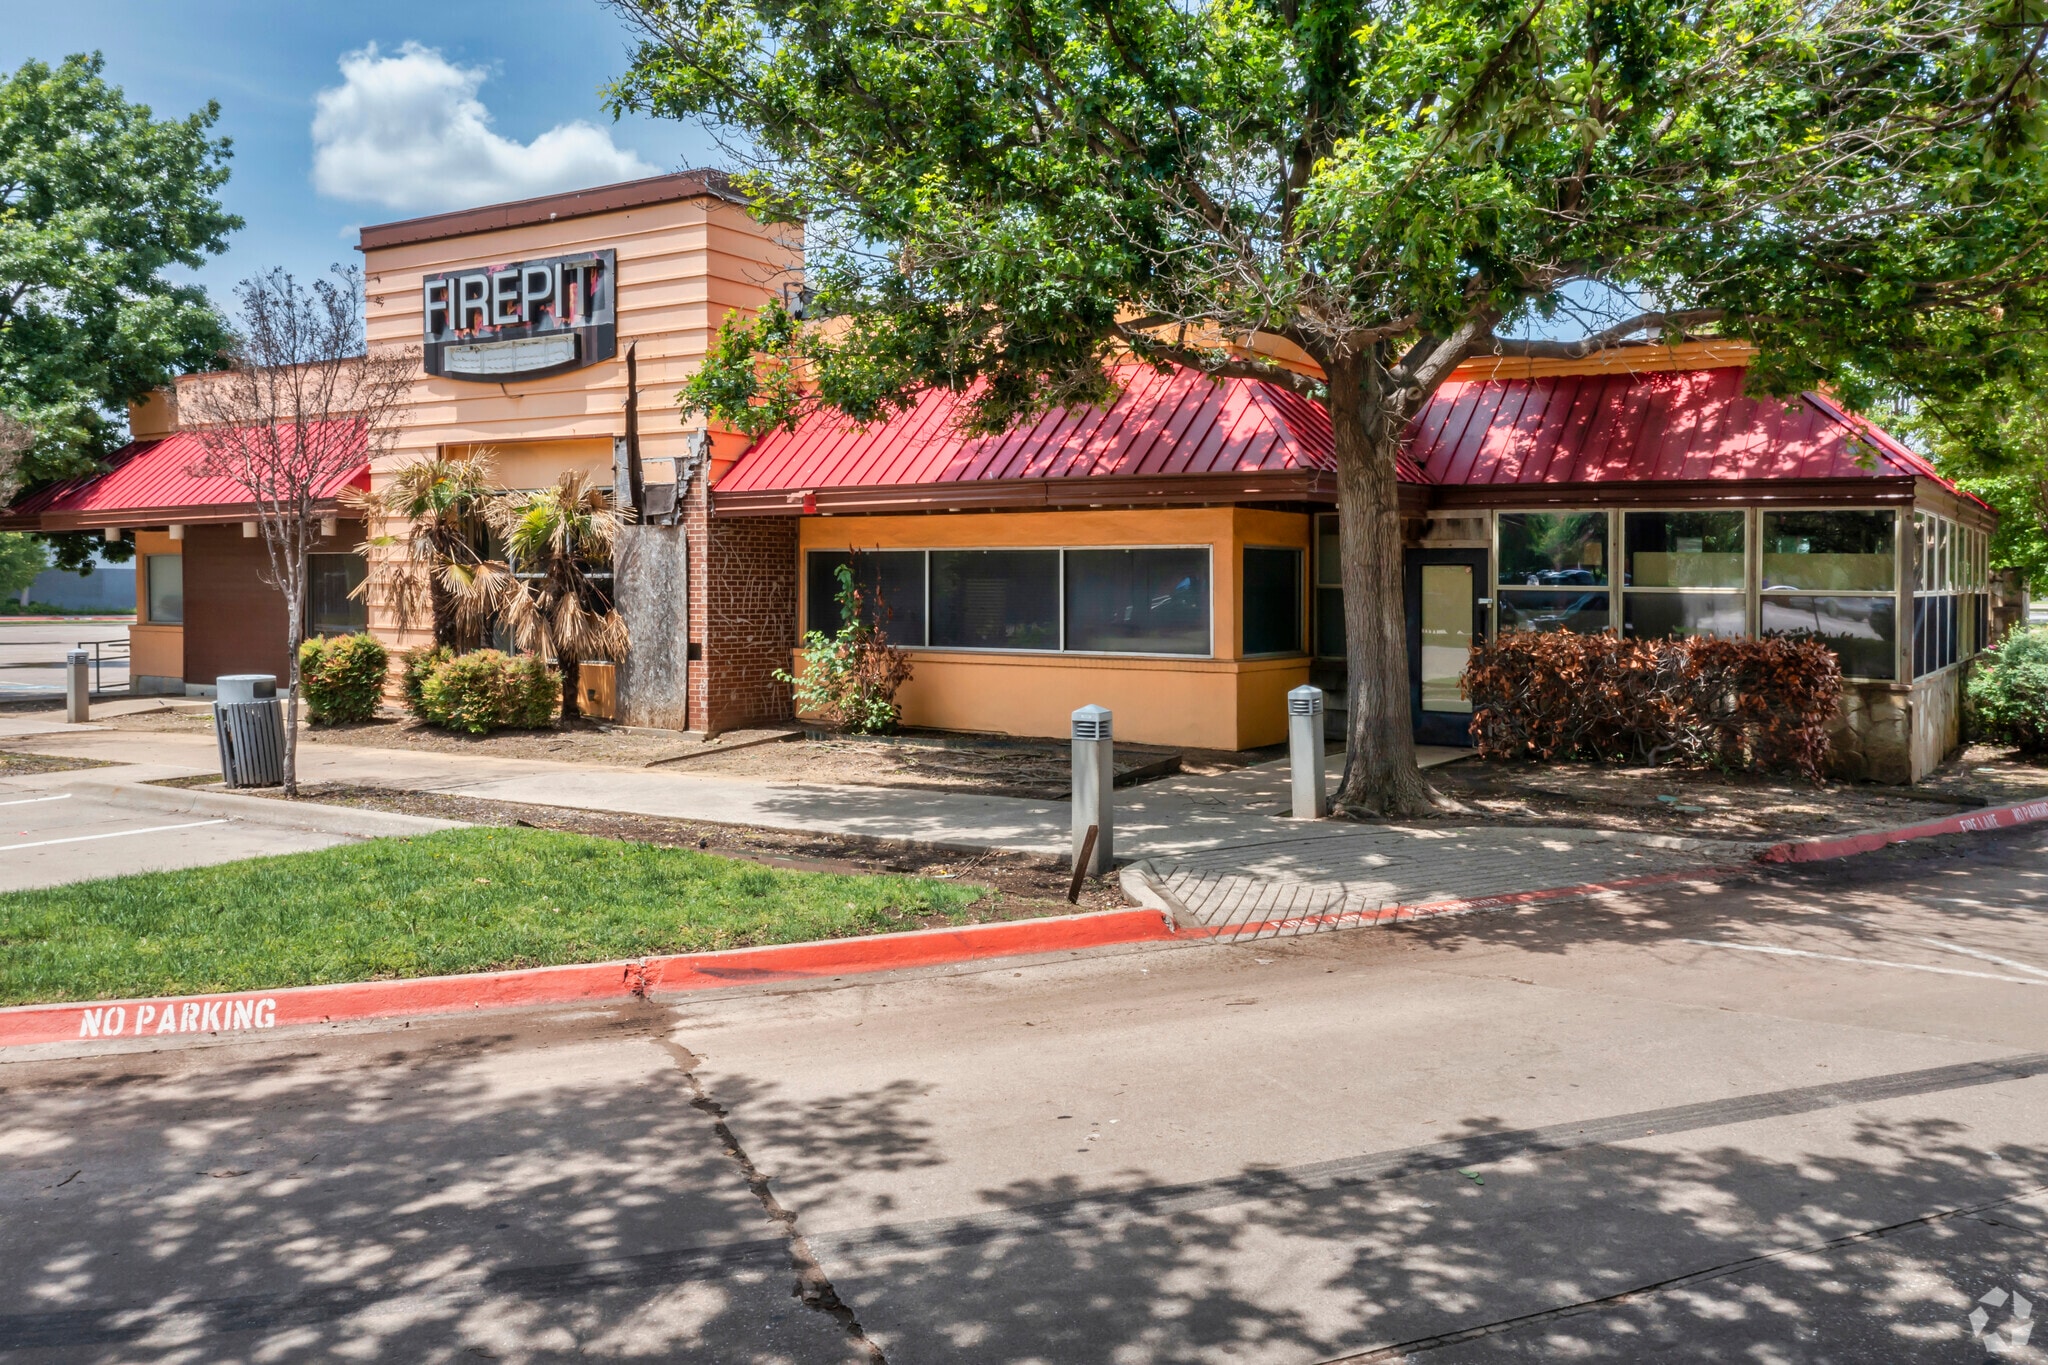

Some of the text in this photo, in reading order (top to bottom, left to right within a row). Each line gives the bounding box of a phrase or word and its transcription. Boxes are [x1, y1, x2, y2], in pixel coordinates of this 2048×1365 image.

[424, 259, 604, 333] FIREPIT
[1959, 818, 1978, 832] FIRE
[2011, 808, 2025, 822] NO
[79, 998, 277, 1037] NO PARKING
